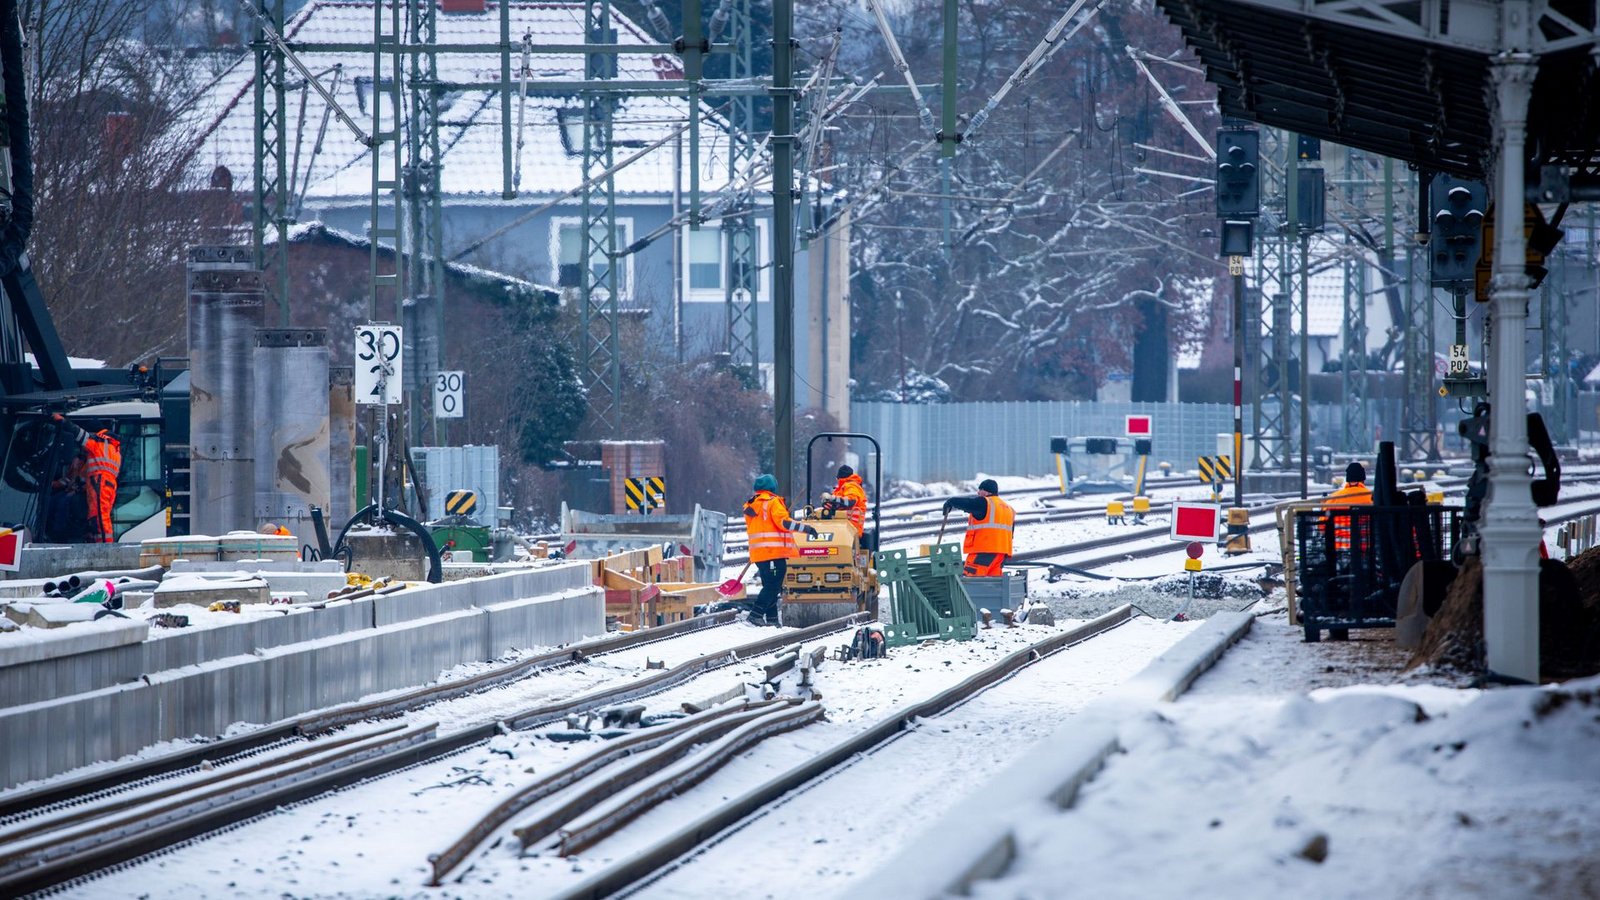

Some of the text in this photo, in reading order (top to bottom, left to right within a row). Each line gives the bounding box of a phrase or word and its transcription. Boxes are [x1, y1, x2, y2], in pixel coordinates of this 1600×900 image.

[359, 331, 400, 360] 30
[1453, 345, 1465, 357] 54
[1451, 360, 1468, 371] P02
[437, 374, 460, 392] 30
[443, 394, 456, 412] 0
